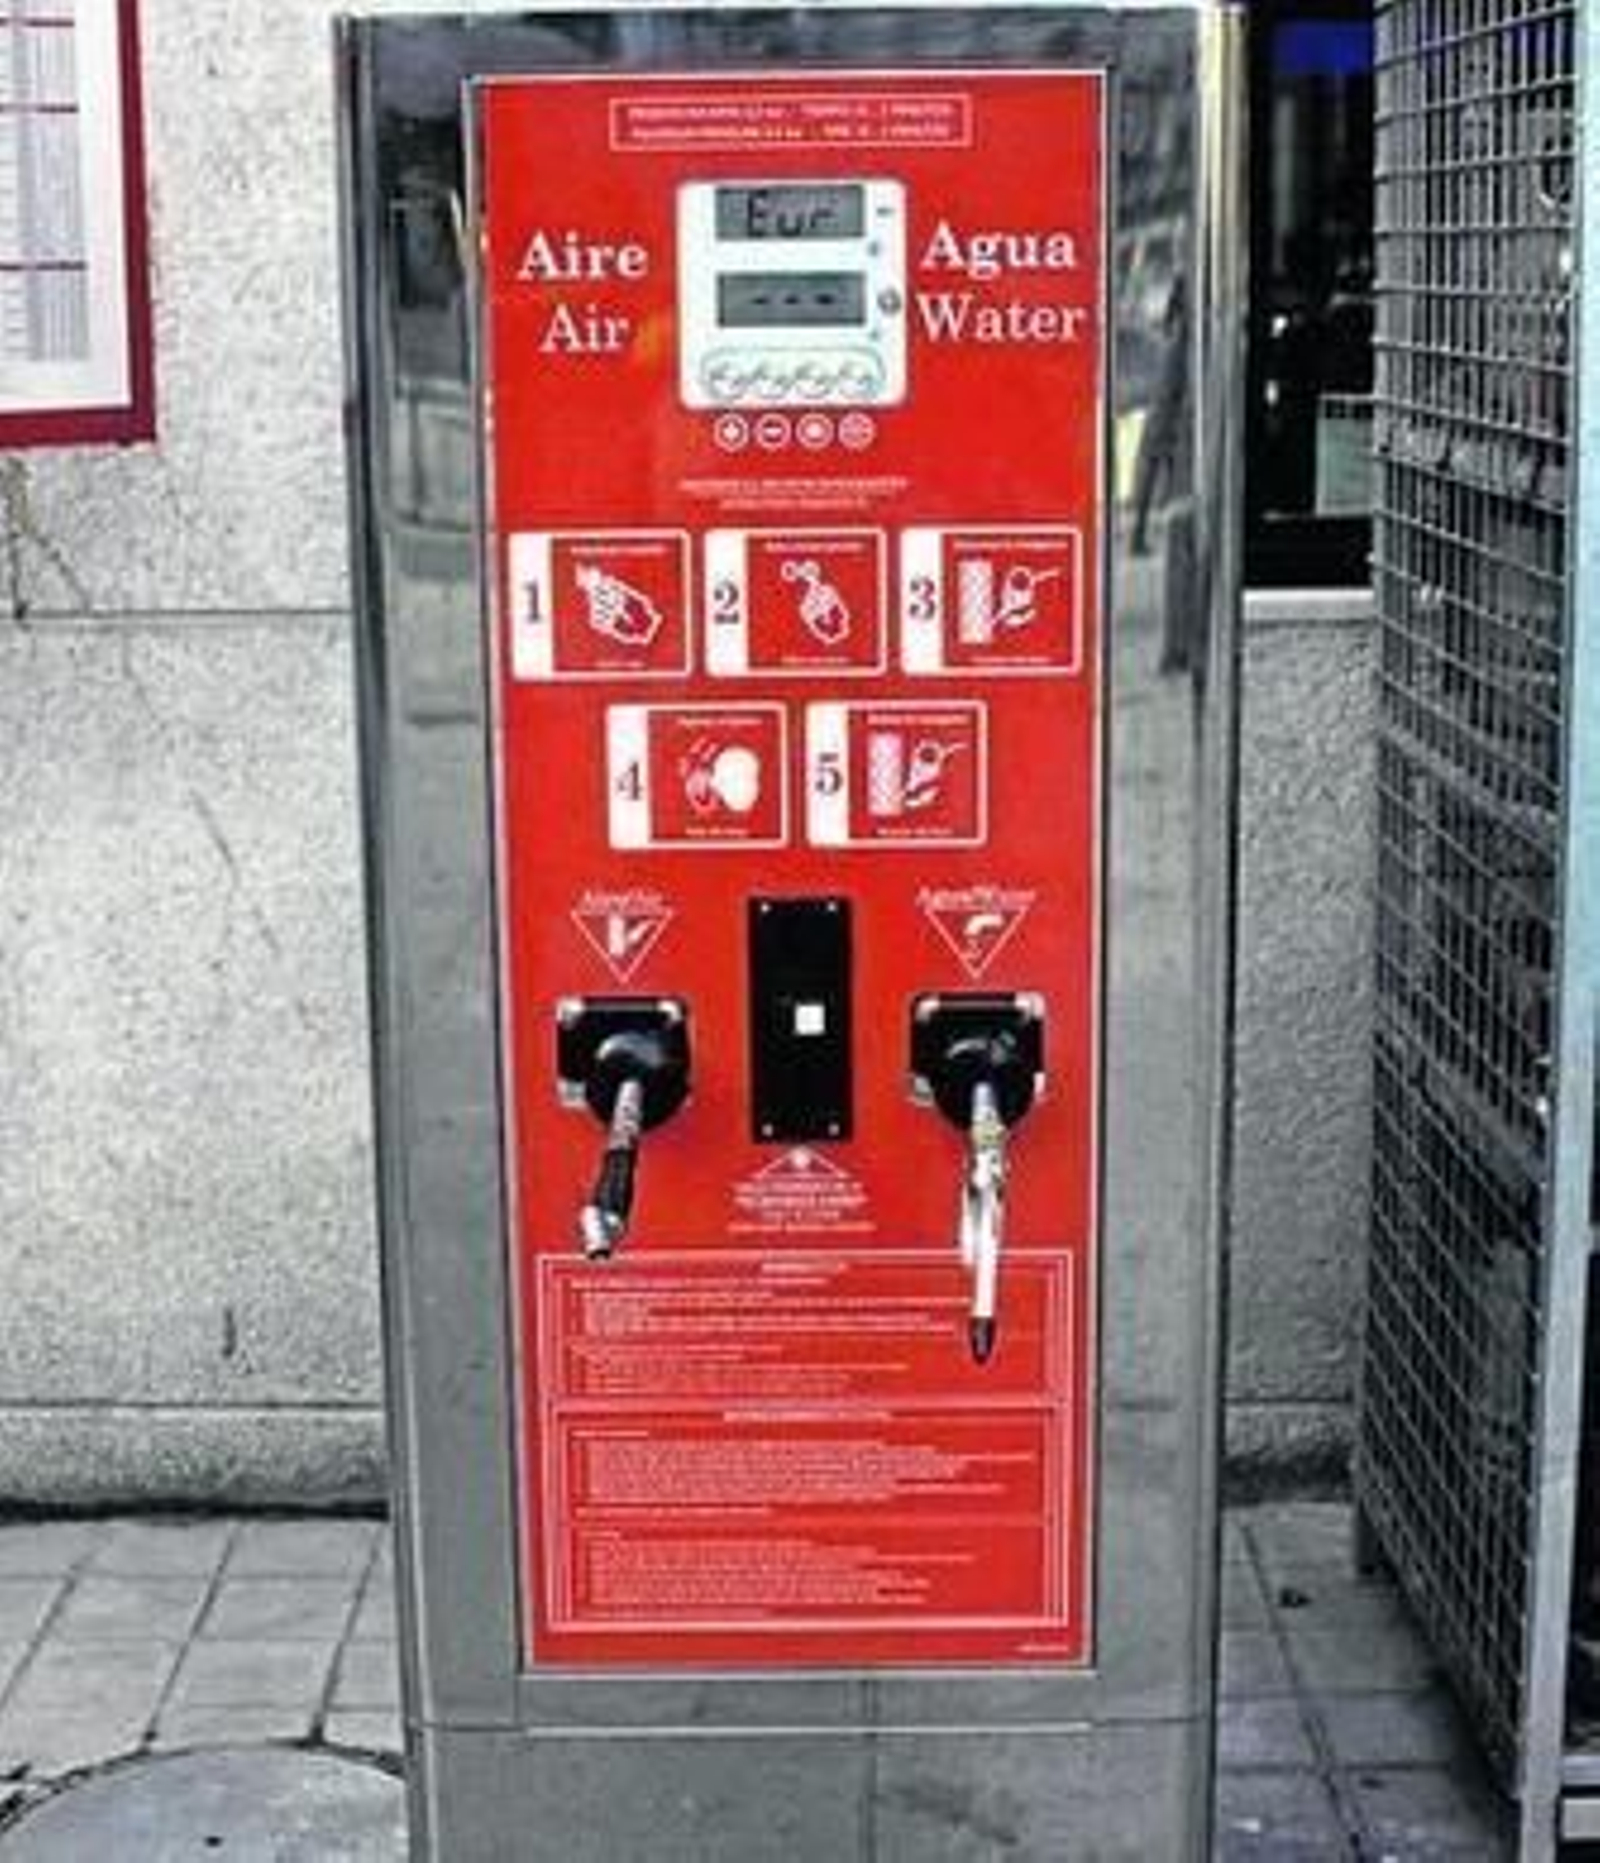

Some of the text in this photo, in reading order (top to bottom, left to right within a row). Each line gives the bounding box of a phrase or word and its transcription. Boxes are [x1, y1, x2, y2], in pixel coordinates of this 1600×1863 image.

[518, 232, 647, 280] Aire
[922, 221, 1077, 281] Agua
[541, 304, 629, 353] Air
[916, 293, 1087, 341] Water
[522, 581, 542, 623] 1
[713, 583, 741, 624] 2
[908, 578, 936, 620] 3
[617, 757, 644, 802] 4
[815, 752, 844, 795] 5
